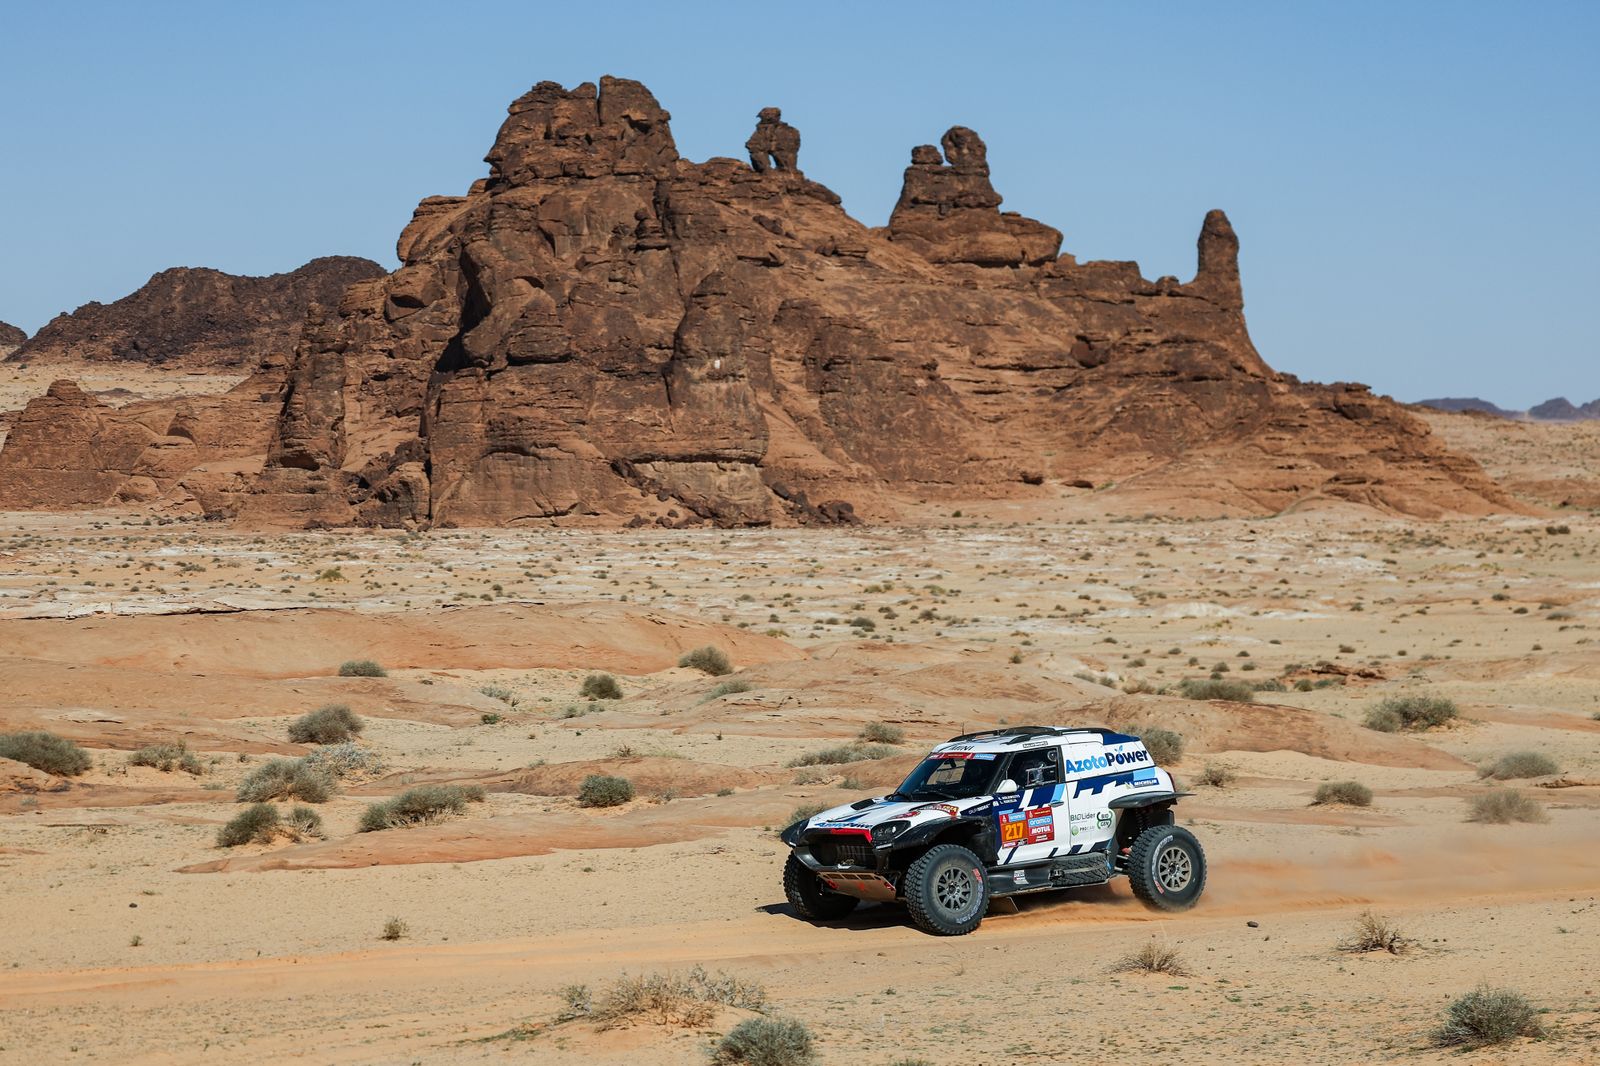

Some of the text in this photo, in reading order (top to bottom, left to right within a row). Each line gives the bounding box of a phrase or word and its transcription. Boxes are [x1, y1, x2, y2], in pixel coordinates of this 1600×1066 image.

[1066, 749, 1148, 774] AzotoPower
[1030, 818, 1051, 826] aramco
[1005, 822, 1024, 840] 217
[1031, 826, 1051, 834] MOTUL
